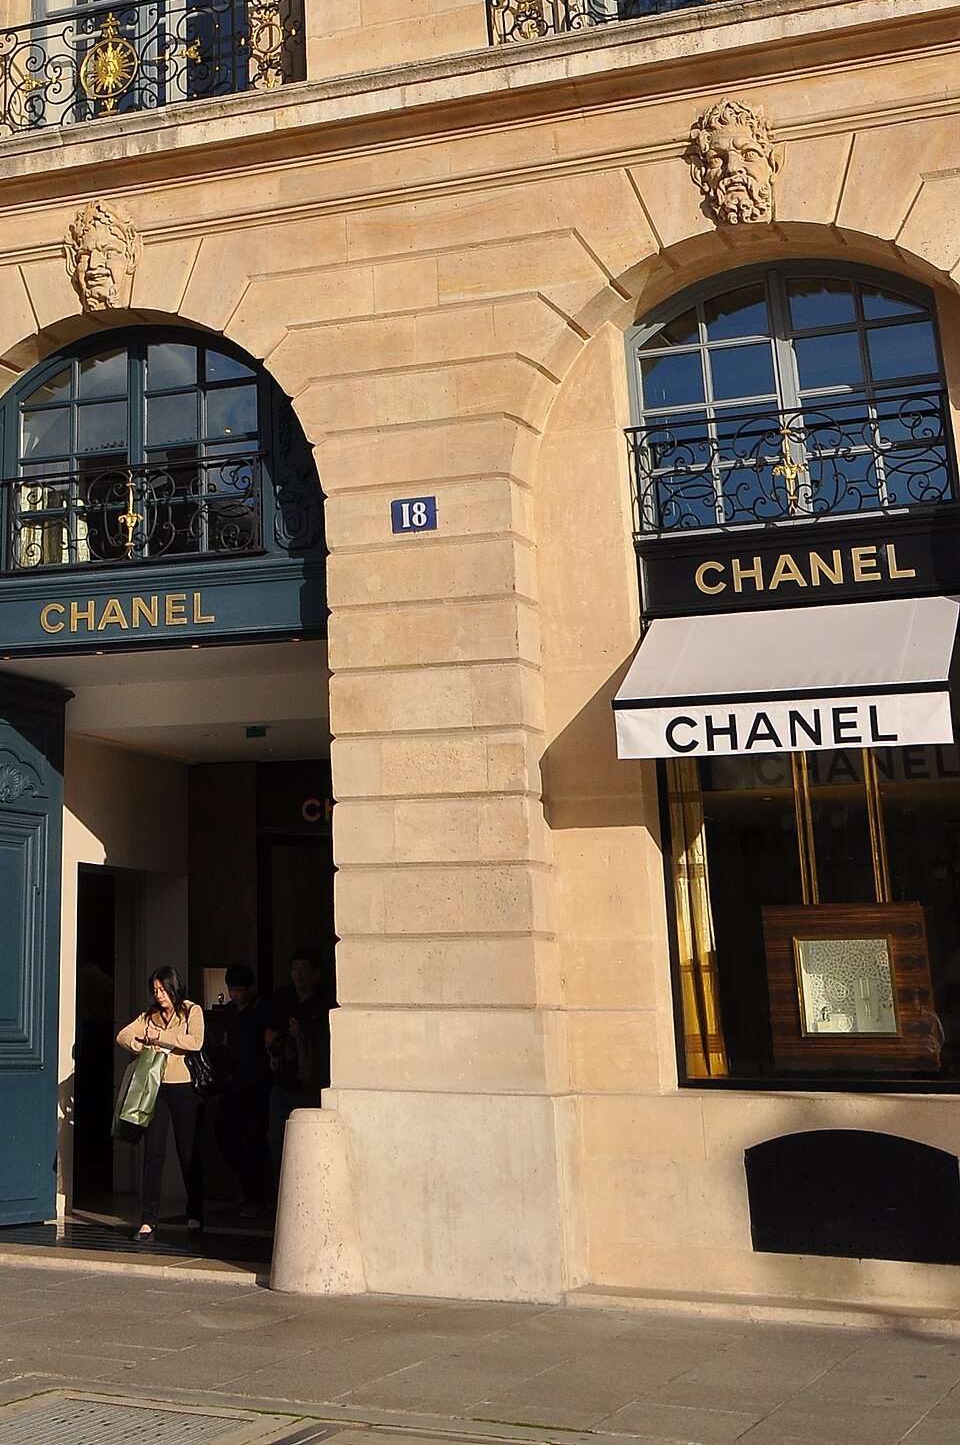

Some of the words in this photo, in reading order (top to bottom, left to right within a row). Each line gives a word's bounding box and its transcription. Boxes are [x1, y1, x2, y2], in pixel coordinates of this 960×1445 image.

[401, 502, 427, 528] 18
[695, 544, 916, 595] CHANEL
[40, 592, 215, 634] CHANEL
[665, 705, 898, 753] CHANEL
